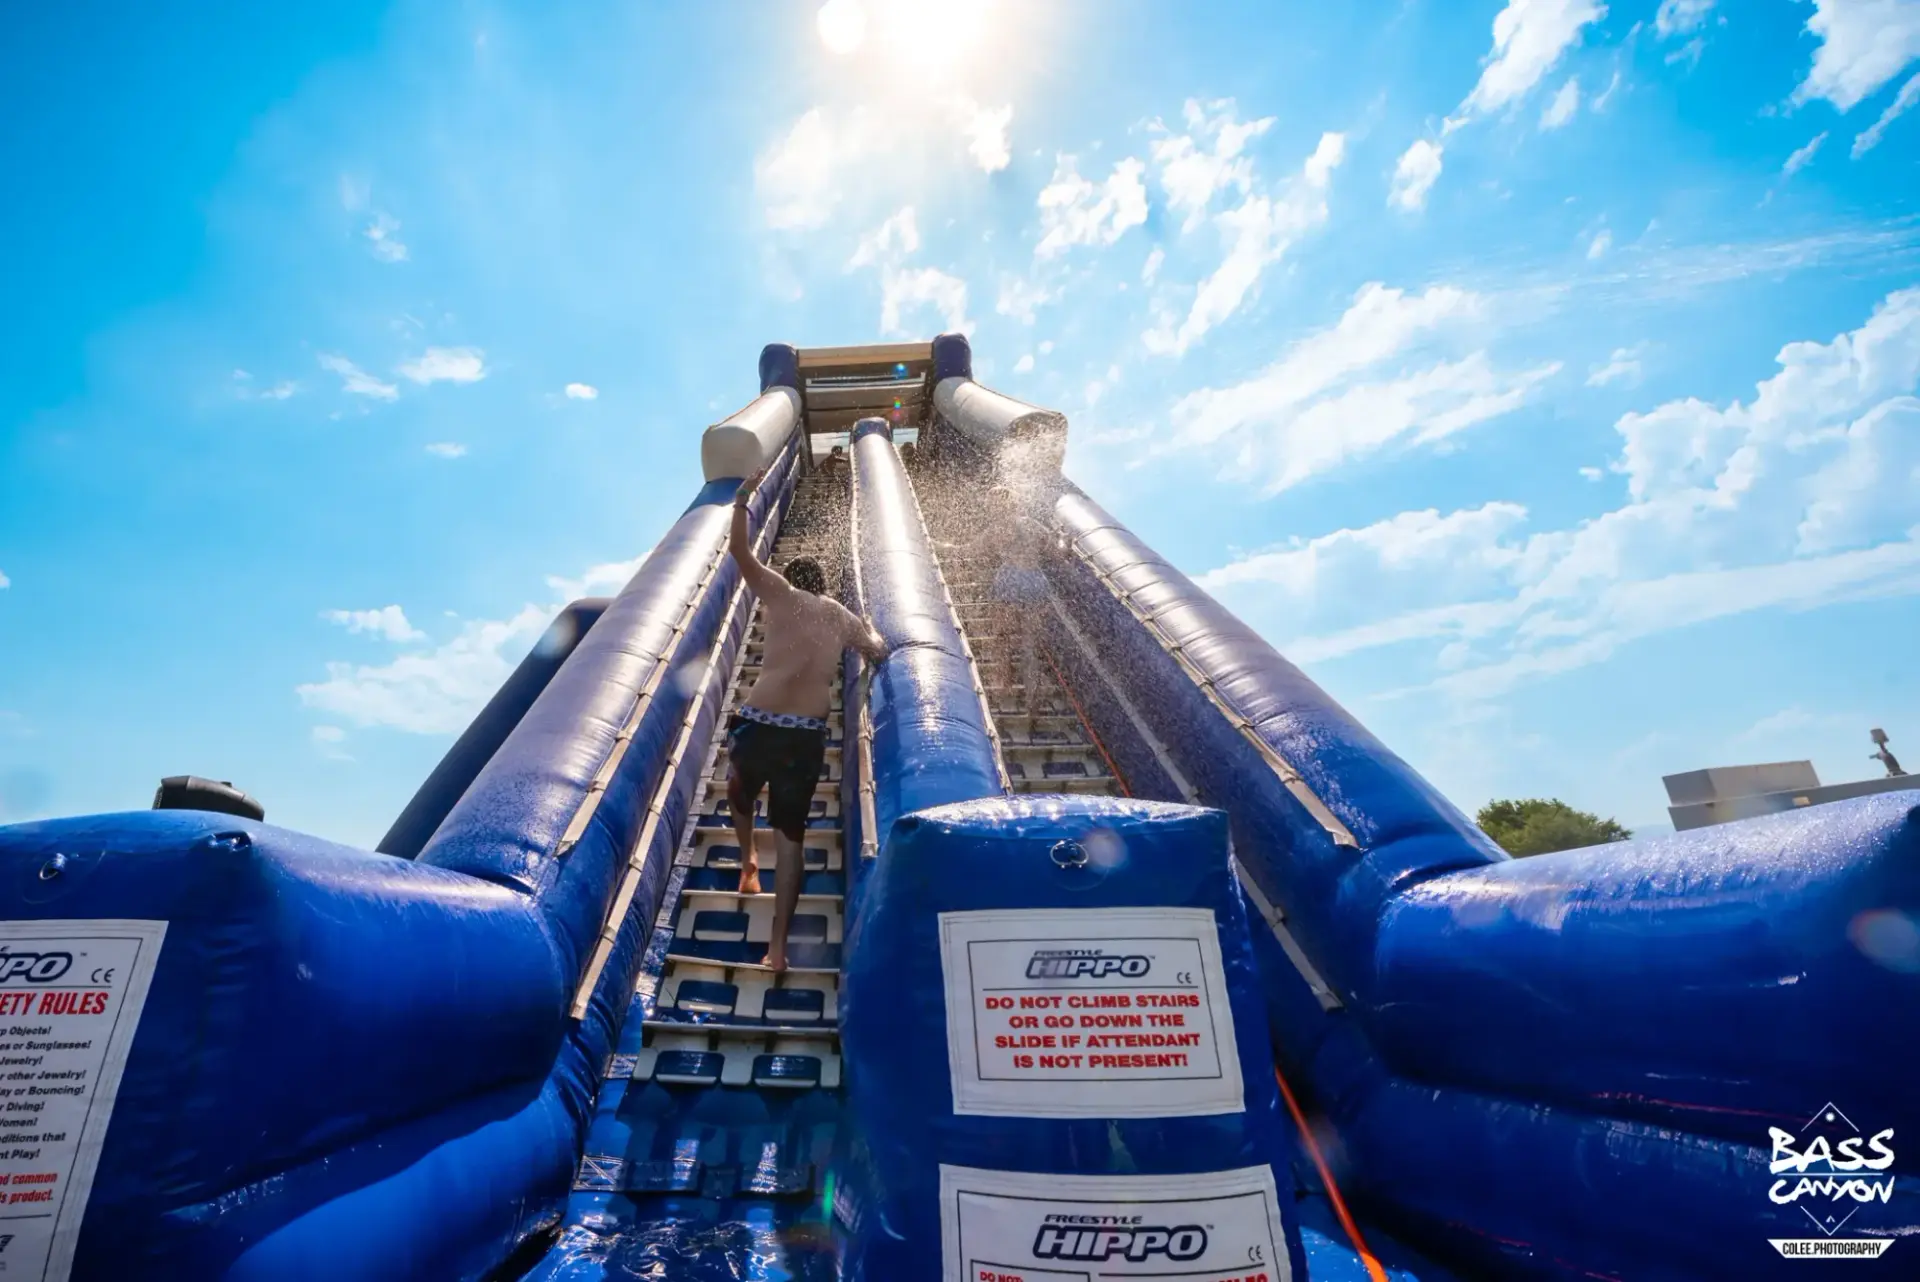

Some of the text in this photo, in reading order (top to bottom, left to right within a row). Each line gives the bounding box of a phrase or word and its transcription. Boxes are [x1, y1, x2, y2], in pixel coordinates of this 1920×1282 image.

[1026, 955, 1151, 979] HIPPO
[0, 992, 109, 1016] ETY RULES
[985, 994, 1200, 1010] DO NOT CLIMB STAIRS
[1009, 1014, 1184, 1029] OR GO DOWN THE
[9, 1026, 52, 1036] Objects!
[12, 1043, 24, 1051] or
[25, 1040, 92, 1052] Sunglasses!
[994, 1033, 1200, 1048] SLIDE IF ATTENDANT
[1014, 1053, 1188, 1068] IS NOT PRESENT!
[7, 1071, 36, 1080] other
[37, 1069, 87, 1081] Jewelry!
[14, 1087, 26, 1096] or
[27, 1084, 86, 1096] Bouncing!
[6, 1100, 46, 1113] Diving!
[0, 1132, 66, 1144] ditions that
[11, 1148, 41, 1161] Play!
[12, 1173, 58, 1185] common
[9, 1189, 53, 1205] product.
[1044, 1214, 1143, 1225] FREESTYLE
[1032, 1224, 1208, 1262] HIPPO
